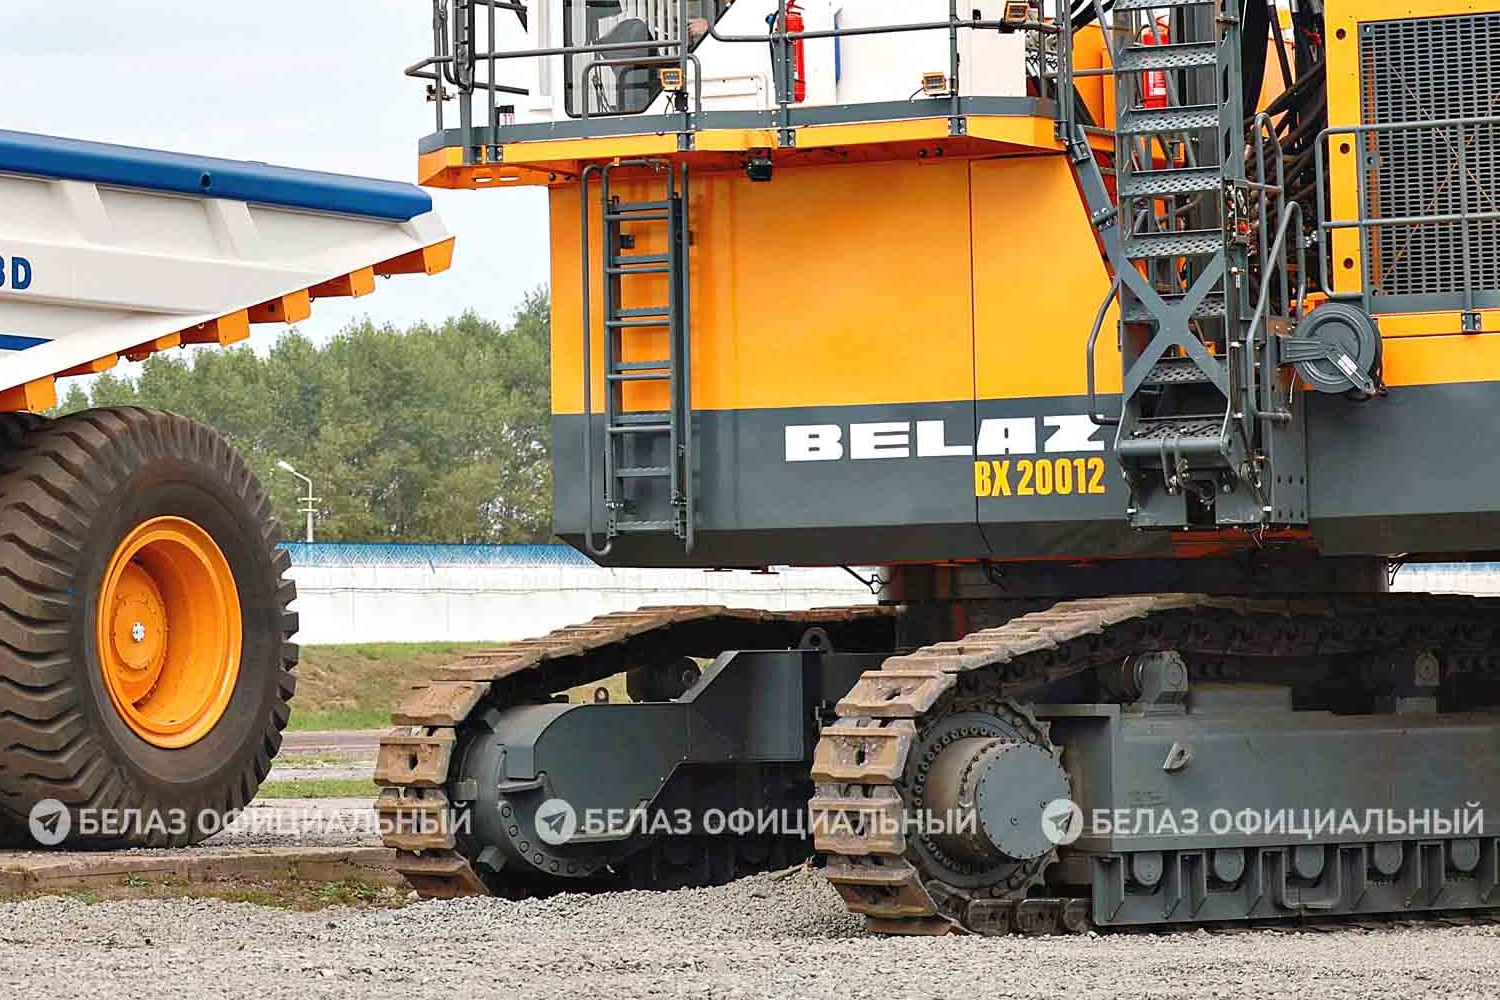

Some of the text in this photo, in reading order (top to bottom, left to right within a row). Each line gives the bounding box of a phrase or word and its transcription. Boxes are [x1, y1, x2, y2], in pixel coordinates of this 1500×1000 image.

[11, 256, 32, 290] D
[785, 413, 1106, 461] BELAZ
[974, 457, 1106, 497] BX 20012
